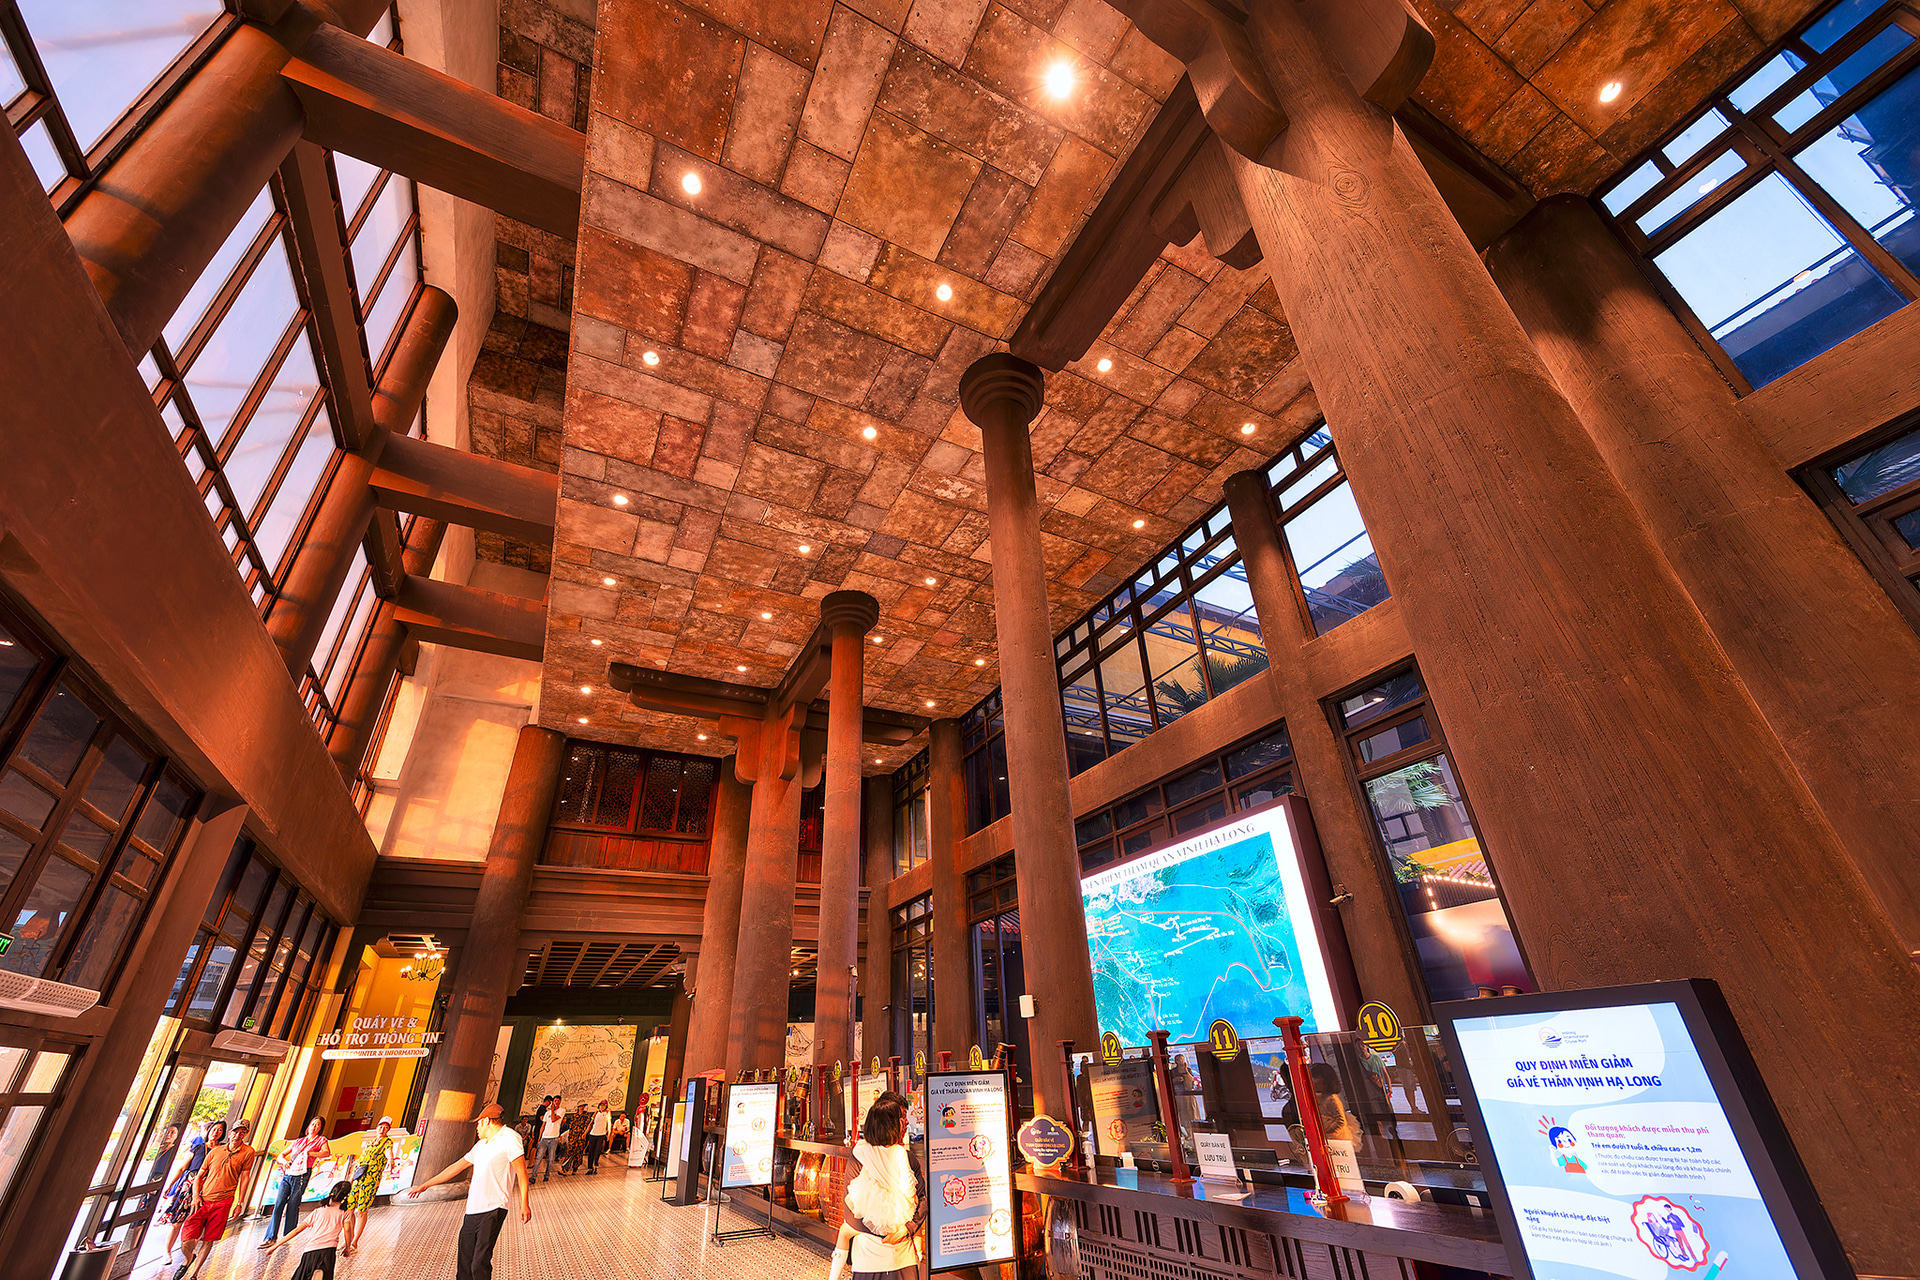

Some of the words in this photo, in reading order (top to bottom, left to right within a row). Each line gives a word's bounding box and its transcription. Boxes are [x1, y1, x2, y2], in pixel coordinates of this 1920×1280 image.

[1222, 823, 1255, 842] LONG
[391, 1015, 405, 1028] VÉ
[407, 1017, 418, 1028] &
[1363, 1013, 1392, 1038] 10
[320, 1029, 342, 1045] HỖ
[345, 1033, 370, 1047] TRỢ
[373, 1031, 416, 1044] THÔNG
[420, 1032, 440, 1043] TIN
[1213, 1028, 1230, 1050] 11
[1103, 1040, 1117, 1057] 12
[916, 1056, 923, 1068] 14
[971, 1052, 980, 1066] 13
[1516, 1061, 1537, 1072] QUY
[1540, 1060, 1568, 1073] ĐỊNH
[1569, 1054, 1599, 1069] MIỄN
[1600, 1054, 1633, 1068] GIẢM
[1507, 1075, 1526, 1088] GIÁ
[1526, 1075, 1540, 1088] VÉ
[1540, 1075, 1573, 1087] THĂM
[1574, 1077, 1604, 1090] VỊNH
[1606, 1077, 1624, 1090] HẠ
[1625, 1075, 1662, 1087] LONG
